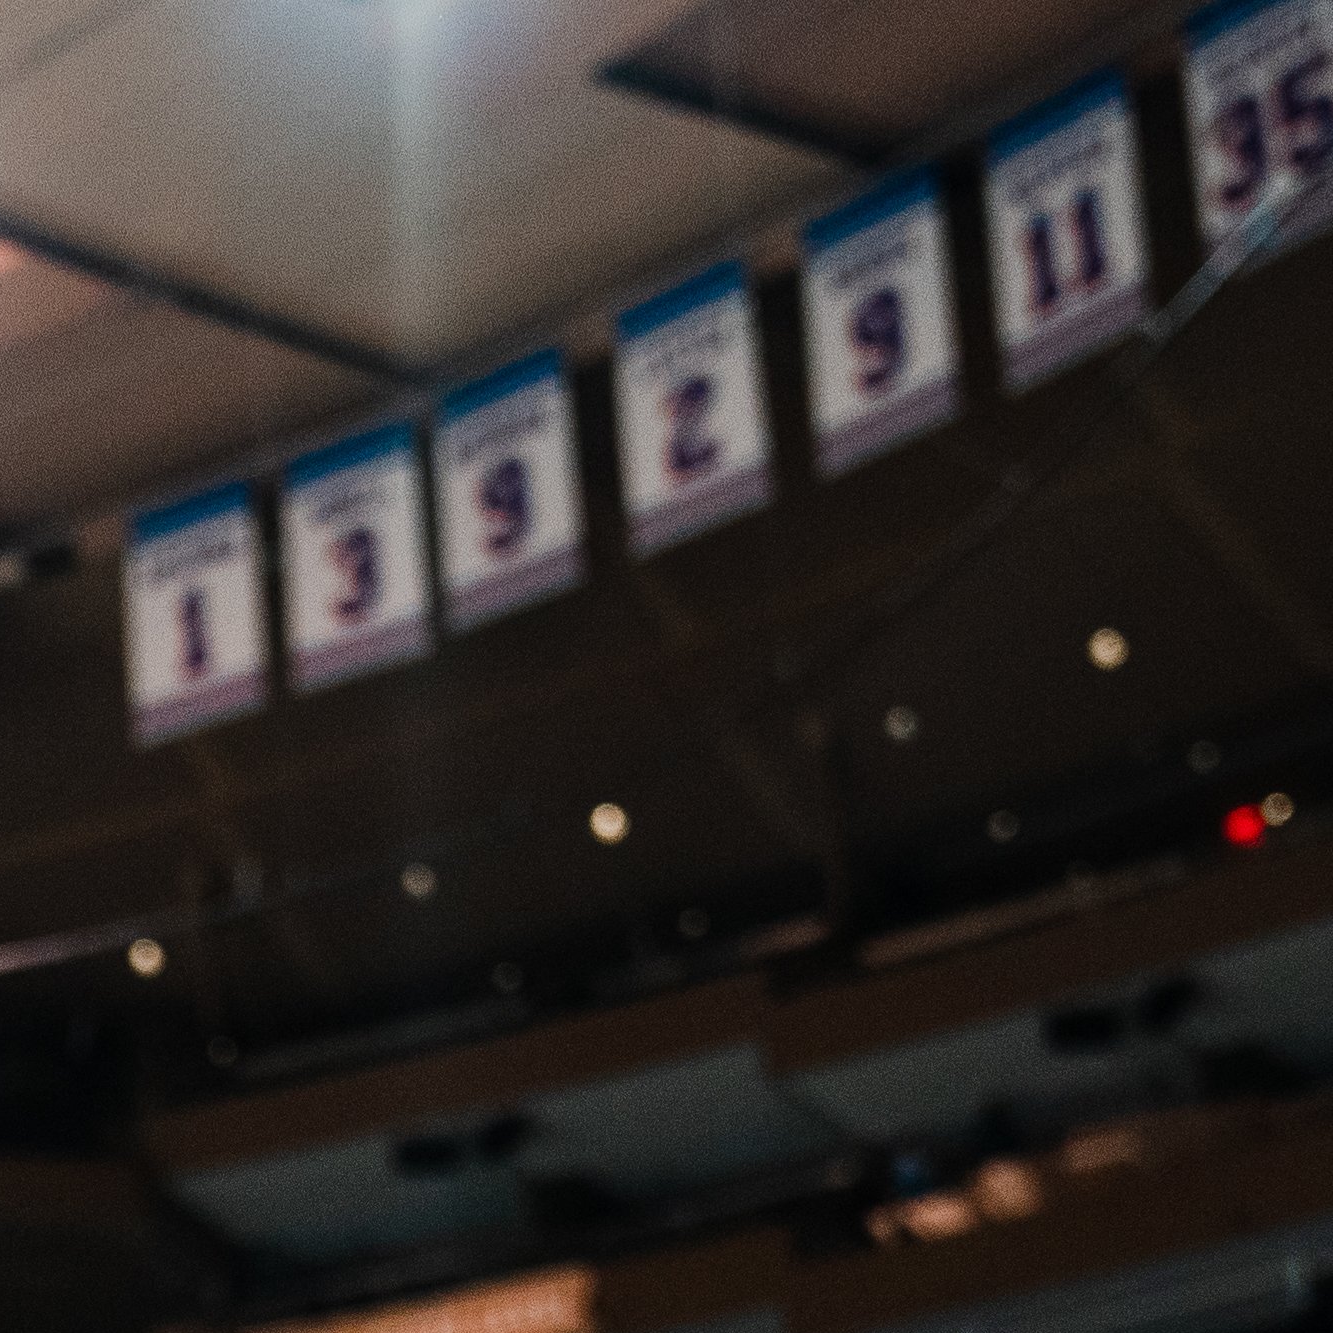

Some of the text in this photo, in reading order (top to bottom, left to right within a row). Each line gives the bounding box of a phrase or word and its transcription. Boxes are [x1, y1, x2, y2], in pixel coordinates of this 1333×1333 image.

[1213, 52, 1333, 212] 35
[1025, 187, 1105, 319] 11
[849, 286, 906, 396] 9
[659, 376, 720, 483] 2
[474, 457, 533, 561] 9
[327, 524, 384, 624] 3
[176, 586, 209, 681] 1
